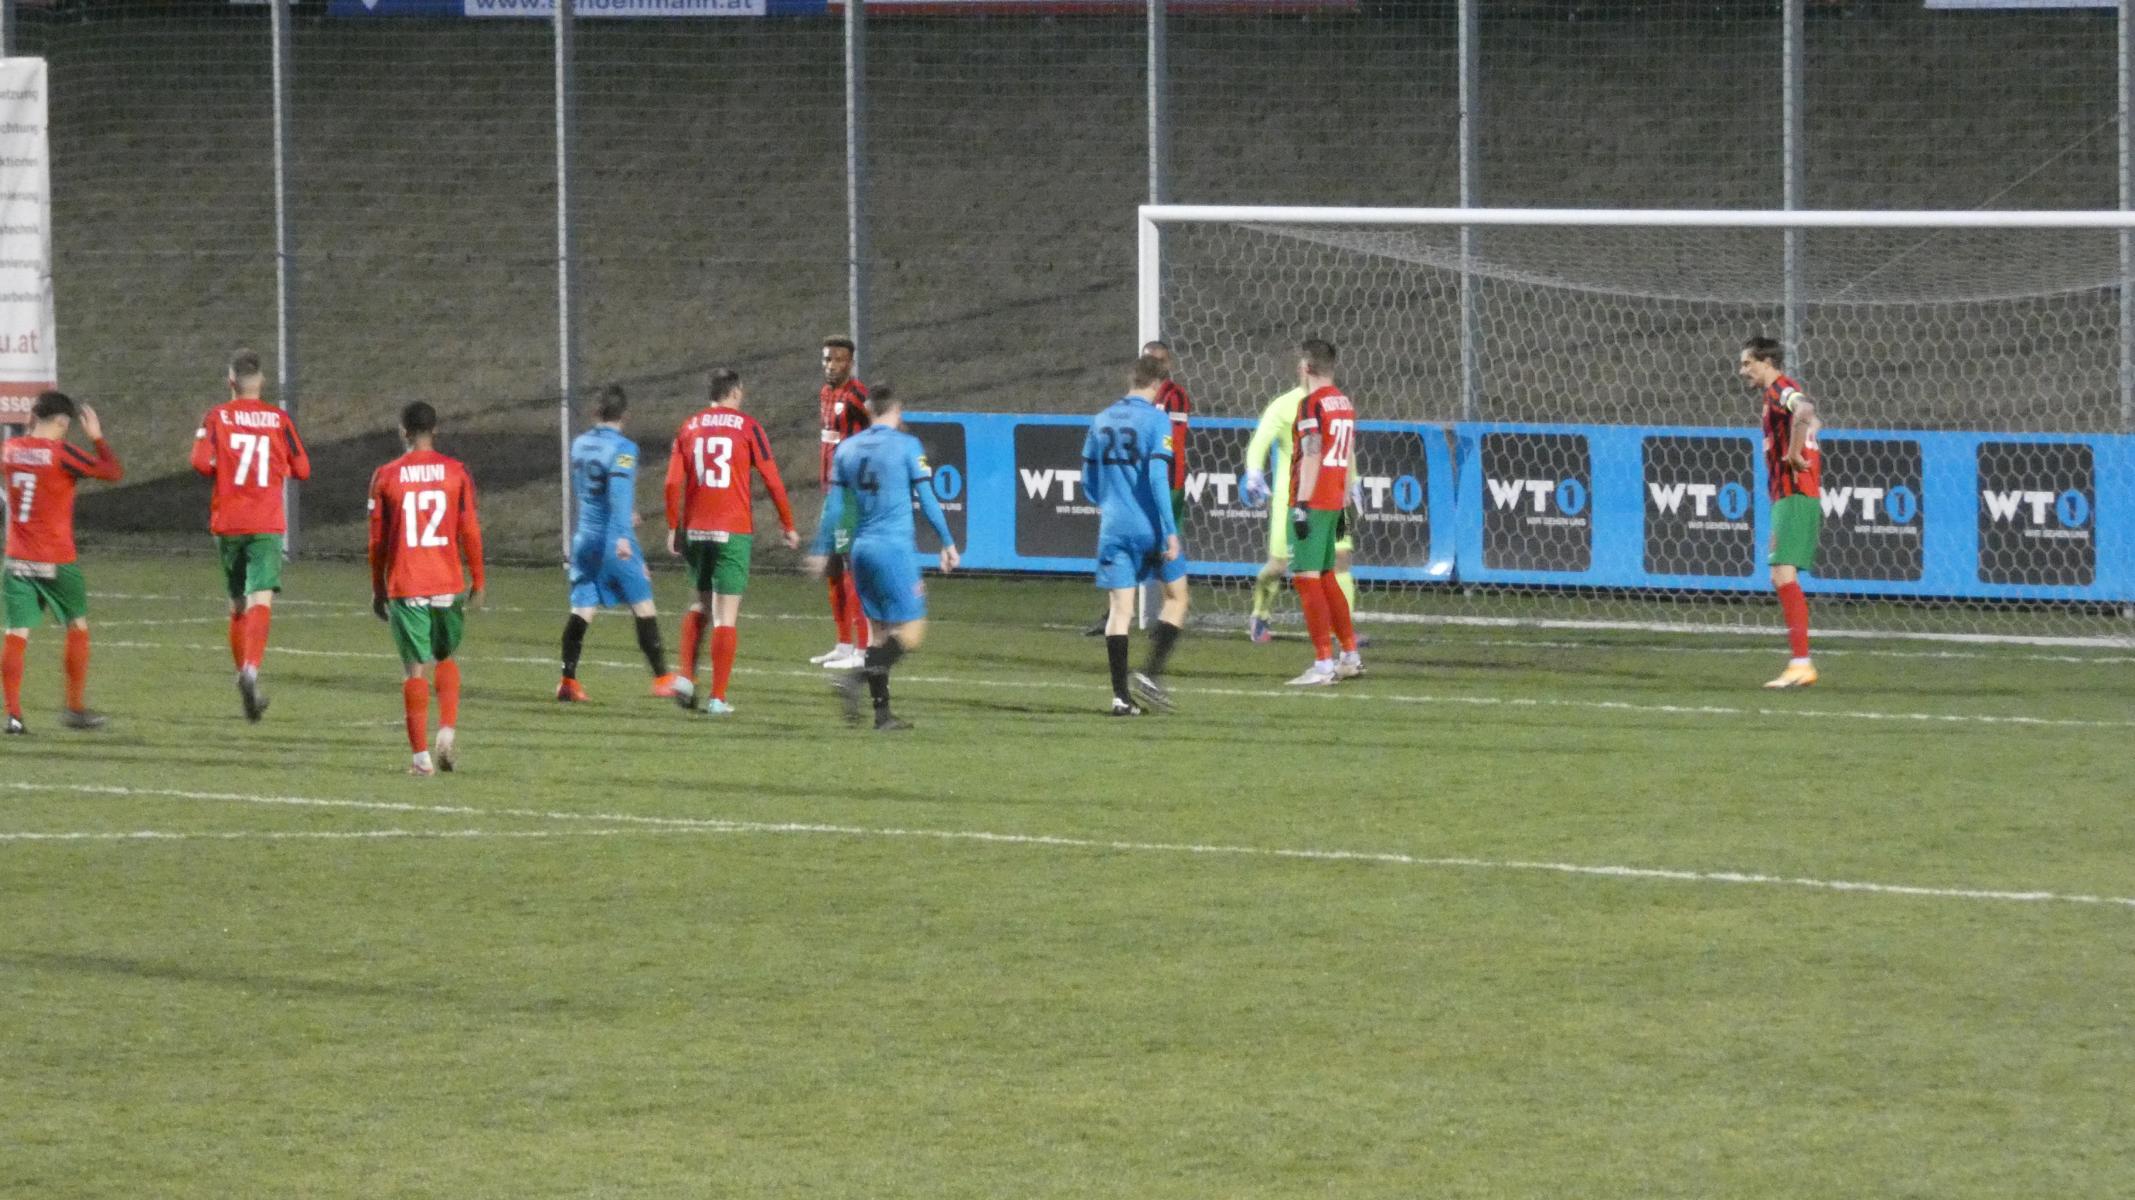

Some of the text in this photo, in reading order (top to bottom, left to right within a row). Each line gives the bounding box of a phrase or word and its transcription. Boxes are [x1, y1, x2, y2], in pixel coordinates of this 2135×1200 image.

[702, 414, 744, 430] BAUER
[1323, 419, 1354, 466] 20
[230, 433, 270, 487] 71
[400, 464, 445, 483] AWUNI
[694, 437, 732, 488] 13
[857, 457, 879, 495] 4
[402, 490, 448, 547] 12
